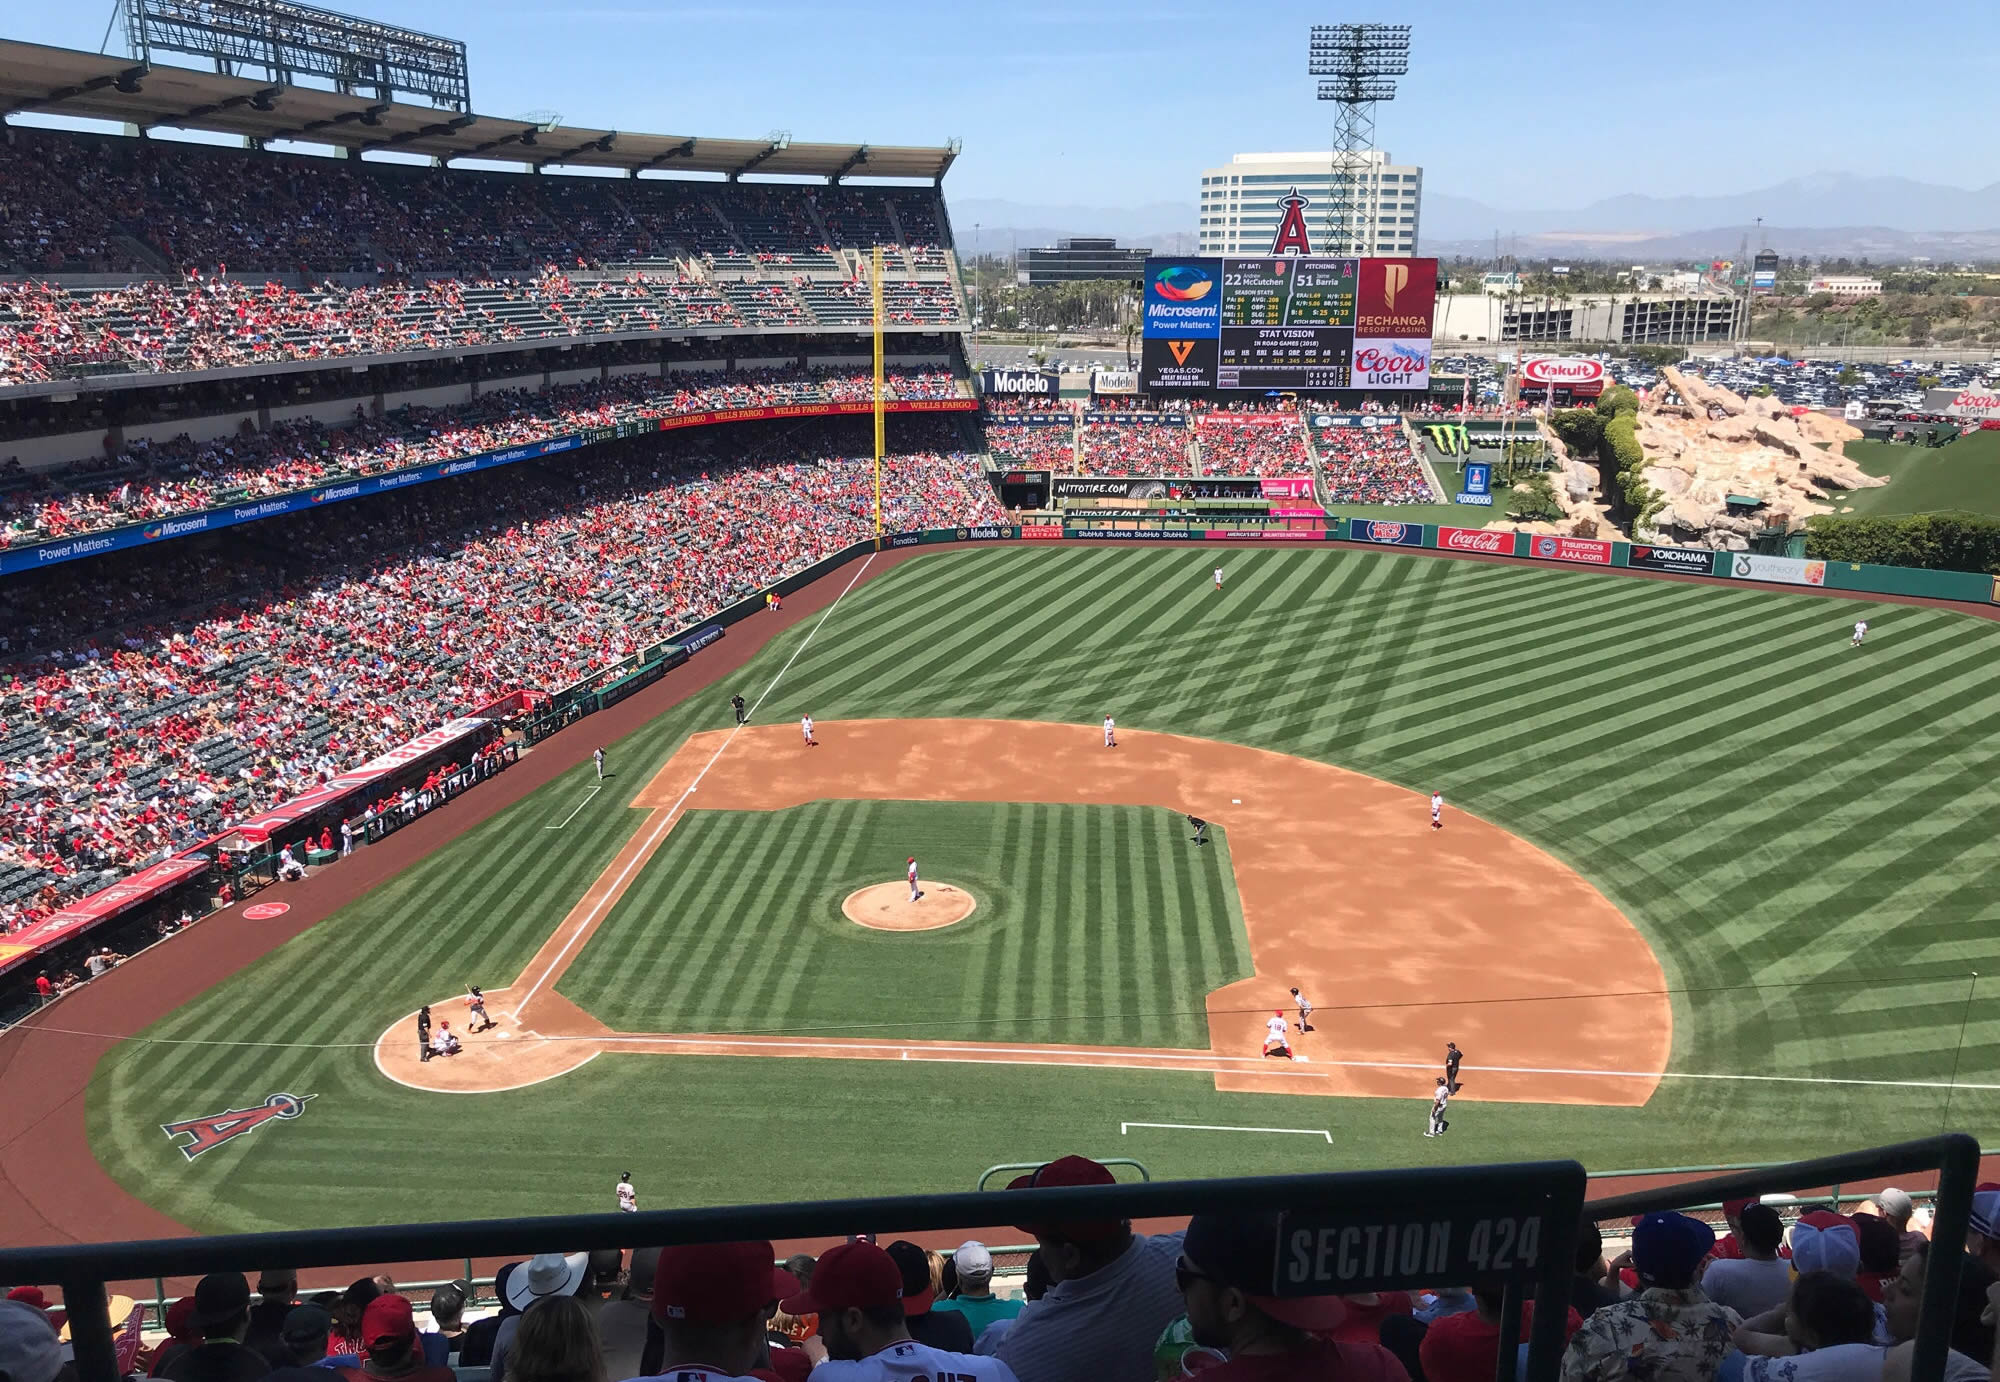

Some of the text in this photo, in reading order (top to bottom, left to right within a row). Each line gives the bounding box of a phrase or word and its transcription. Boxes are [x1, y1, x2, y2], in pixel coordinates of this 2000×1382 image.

[1225, 274, 1241, 285] 22
[1297, 275, 1313, 286] 51
[1148, 304, 1217, 317] Microsemi
[1358, 316, 1426, 326] PECHANGA
[1355, 348, 1427, 372] Coors
[1539, 365, 1590, 376] Yakult
[994, 373, 1048, 392] Modelo
[1102, 376, 1132, 387] Modelo
[1368, 373, 1412, 384] LIGHT
[1953, 390, 2000, 408] Coors
[664, 405, 829, 426] WELLS FARGO WELLS FARGO WELLS FARGO
[1960, 407, 1991, 415] LIGHT
[1058, 483, 1127, 494] NITTOTIRE.COM
[1291, 483, 1311, 497] LA
[39, 544, 71, 560] Power
[162, 516, 208, 536] Microsemi
[234, 505, 258, 519] Power
[325, 484, 359, 500] Microsemi
[379, 478, 397, 488] Power
[450, 458, 477, 473] Microsemi
[493, 453, 507, 463] Power
[549, 439, 571, 451] Microsemi
[971, 528, 998, 538] Modelo
[893, 537, 918, 546] Fanatics
[1448, 530, 1503, 550] Coca-Cola
[1562, 540, 1604, 550] Insurance
[1560, 552, 1602, 561] AAA.com
[1652, 549, 1706, 564] YOKOHAMA
[1753, 561, 1800, 576] youtheory
[390, 730, 456, 758] 2018
[1288, 1216, 1542, 1283] SECTION 424
